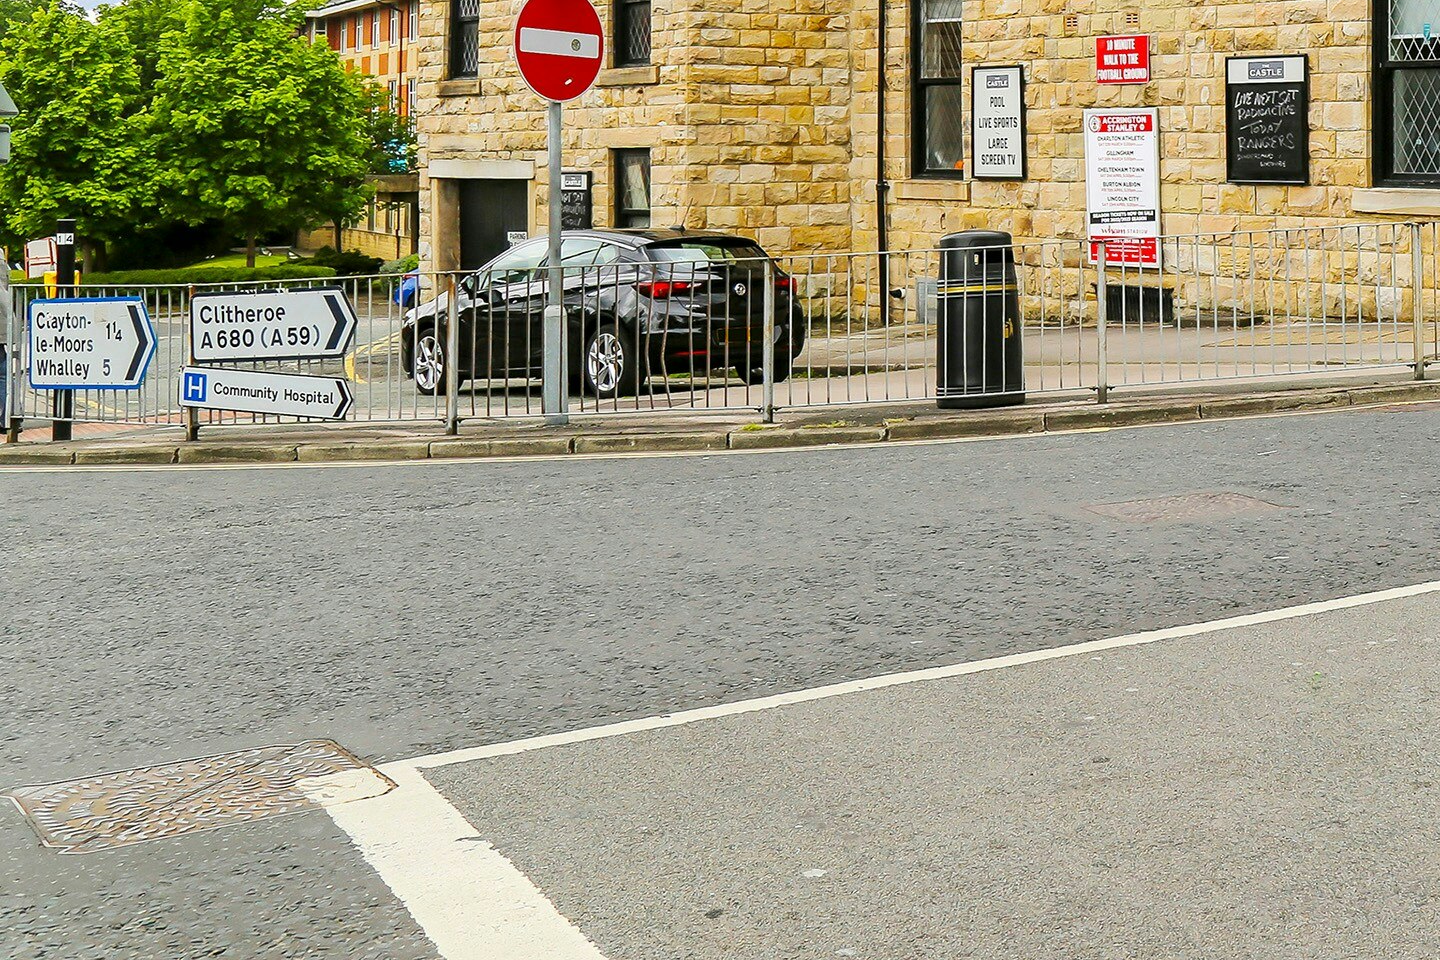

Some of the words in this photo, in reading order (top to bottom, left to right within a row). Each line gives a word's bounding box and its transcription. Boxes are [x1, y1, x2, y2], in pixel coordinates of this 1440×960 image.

[1119, 53, 1127, 65] TO
[1127, 53, 1139, 65] THE
[1249, 68, 1283, 77] CASTLE
[989, 96, 1006, 108] POOL
[1234, 91, 1254, 109] LIVE
[1254, 90, 1279, 106] NEXT
[1278, 89, 1299, 106] SAT
[978, 117, 992, 129] LIVE
[993, 116, 1018, 128] SPORTS
[1102, 116, 1147, 124] ACCRINGTON
[1240, 119, 1283, 135] TODAY
[1107, 124, 1138, 132] STANLEY
[988, 137, 1009, 149] LARGE
[1237, 132, 1295, 152] RANGERS
[981, 154, 1006, 166] SCREEN
[1007, 154, 1016, 165] TV
[199, 305, 286, 325] Clitheroe
[36, 312, 92, 333] Clayton-
[36, 337, 93, 353] le-Moors
[36, 359, 90, 381] Whalley
[102, 358, 111, 377] 5
[213, 382, 279, 401] Community
[284, 389, 335, 406] Hospital
